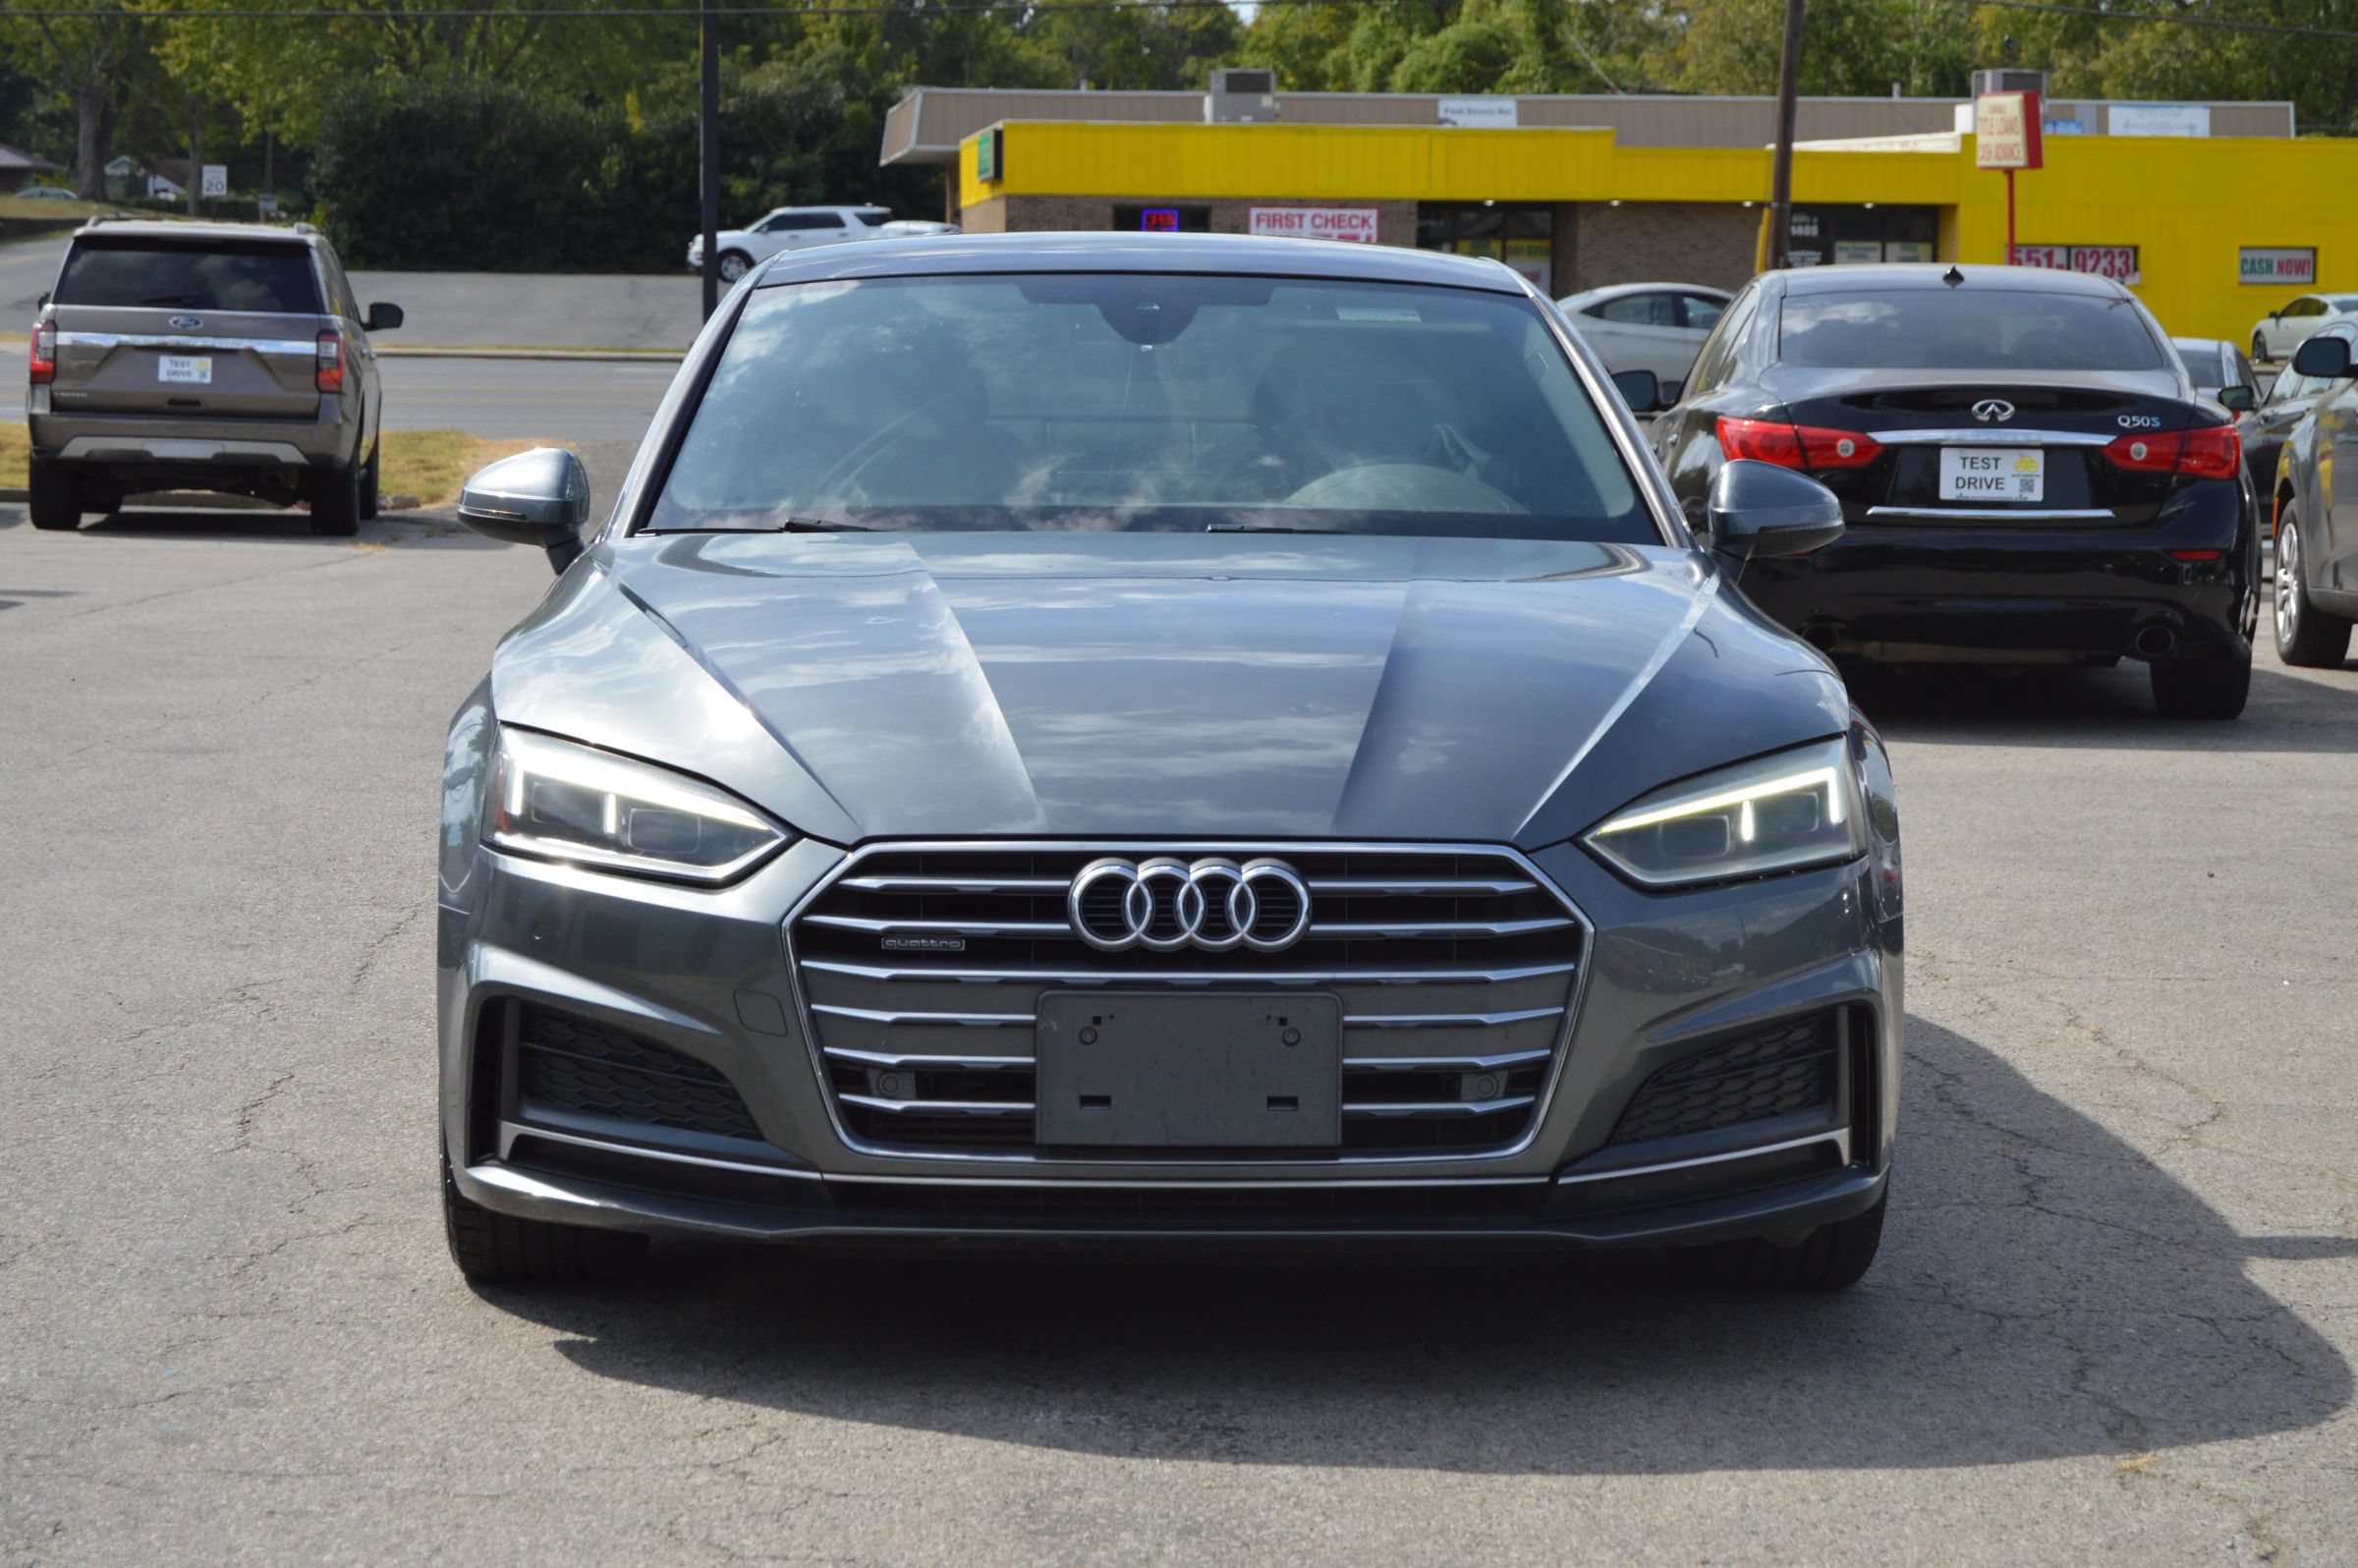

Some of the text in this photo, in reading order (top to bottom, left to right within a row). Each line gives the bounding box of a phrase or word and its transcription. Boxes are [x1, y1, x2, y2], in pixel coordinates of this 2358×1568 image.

[205, 180, 224, 193] 20
[1256, 213, 1373, 230] FIRST CHECK
[2241, 257, 2312, 275] CASH NOW!
[169, 360, 191, 368] TEST
[166, 369, 192, 378] DRIVE
[2117, 415, 2162, 428] Q50S
[1959, 456, 2002, 471] TEST
[1955, 476, 2005, 491] DRIVE
[884, 938, 962, 950] quattro
